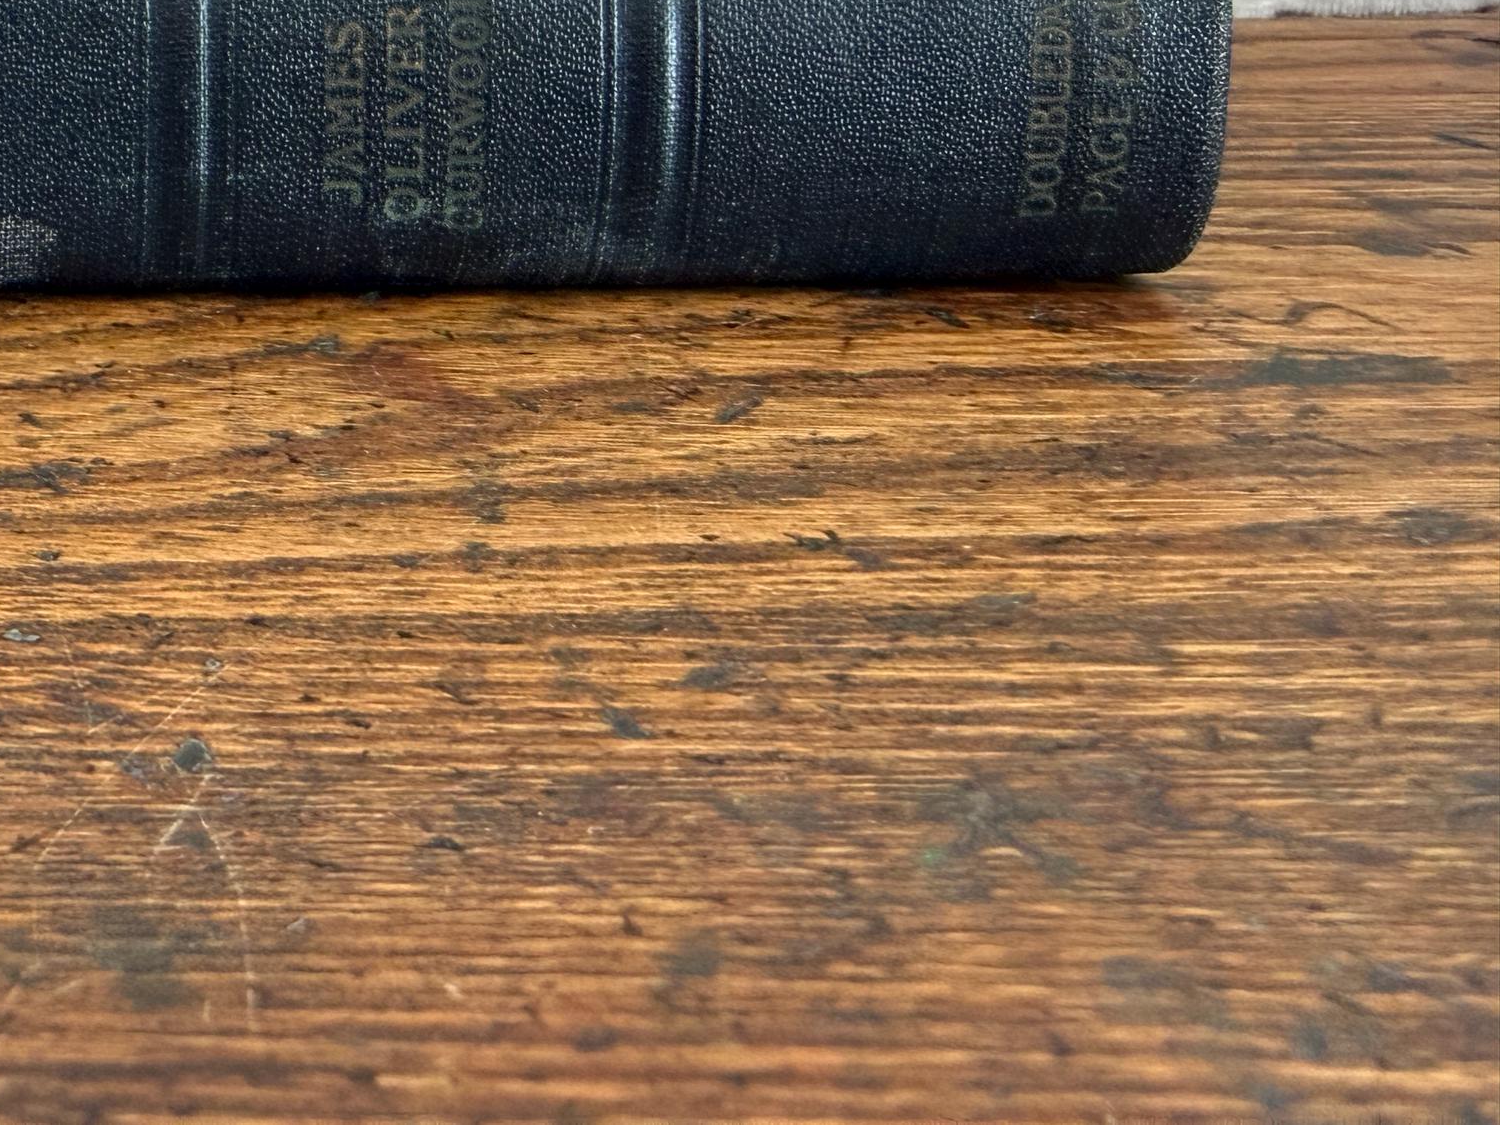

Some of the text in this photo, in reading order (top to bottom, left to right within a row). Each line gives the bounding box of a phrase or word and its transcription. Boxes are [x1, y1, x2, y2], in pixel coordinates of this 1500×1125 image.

[323, 21, 366, 205] JAMES
[383, 6, 426, 221] OLIVER
[1079, 101, 1134, 215] PAGE
